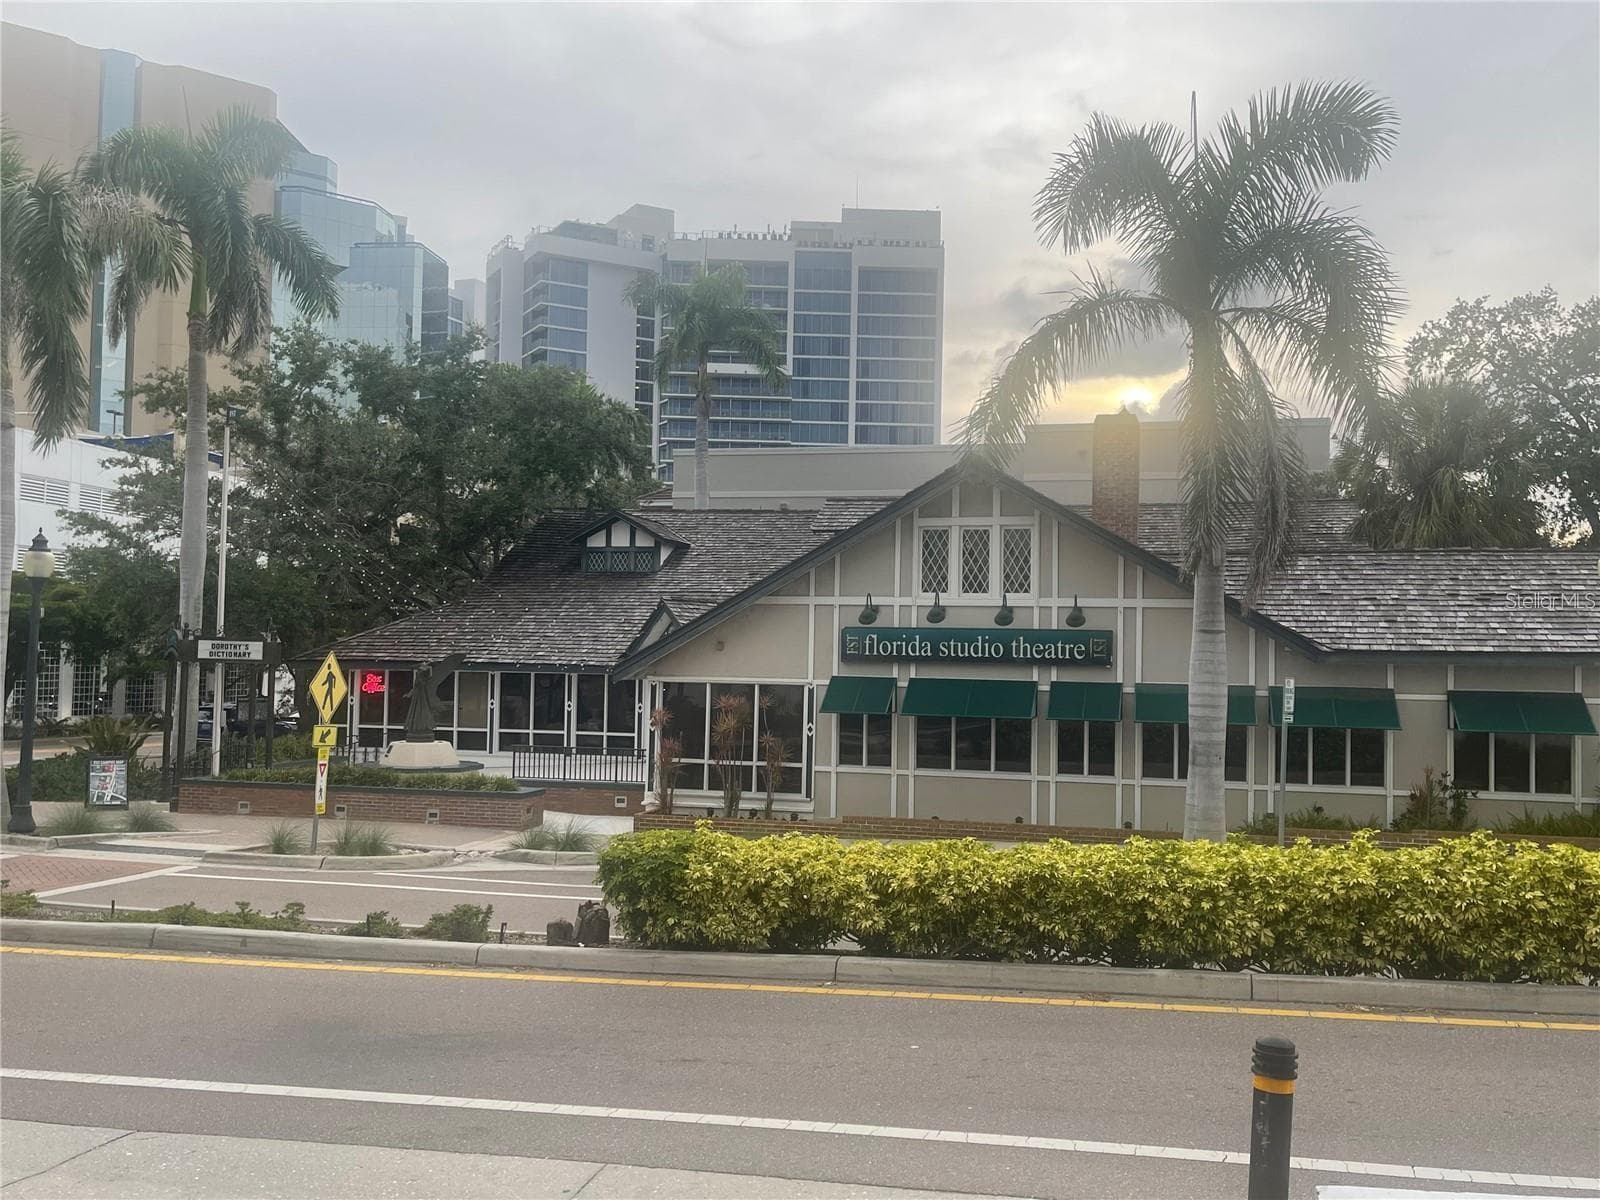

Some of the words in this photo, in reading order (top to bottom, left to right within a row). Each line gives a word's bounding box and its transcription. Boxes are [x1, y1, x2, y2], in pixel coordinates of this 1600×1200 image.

[209, 650, 251, 658] DICTIONARY
[846, 634, 859, 655] FST
[863, 633, 932, 657] florida
[939, 635, 1004, 658] studio
[1010, 636, 1086, 660] theatre
